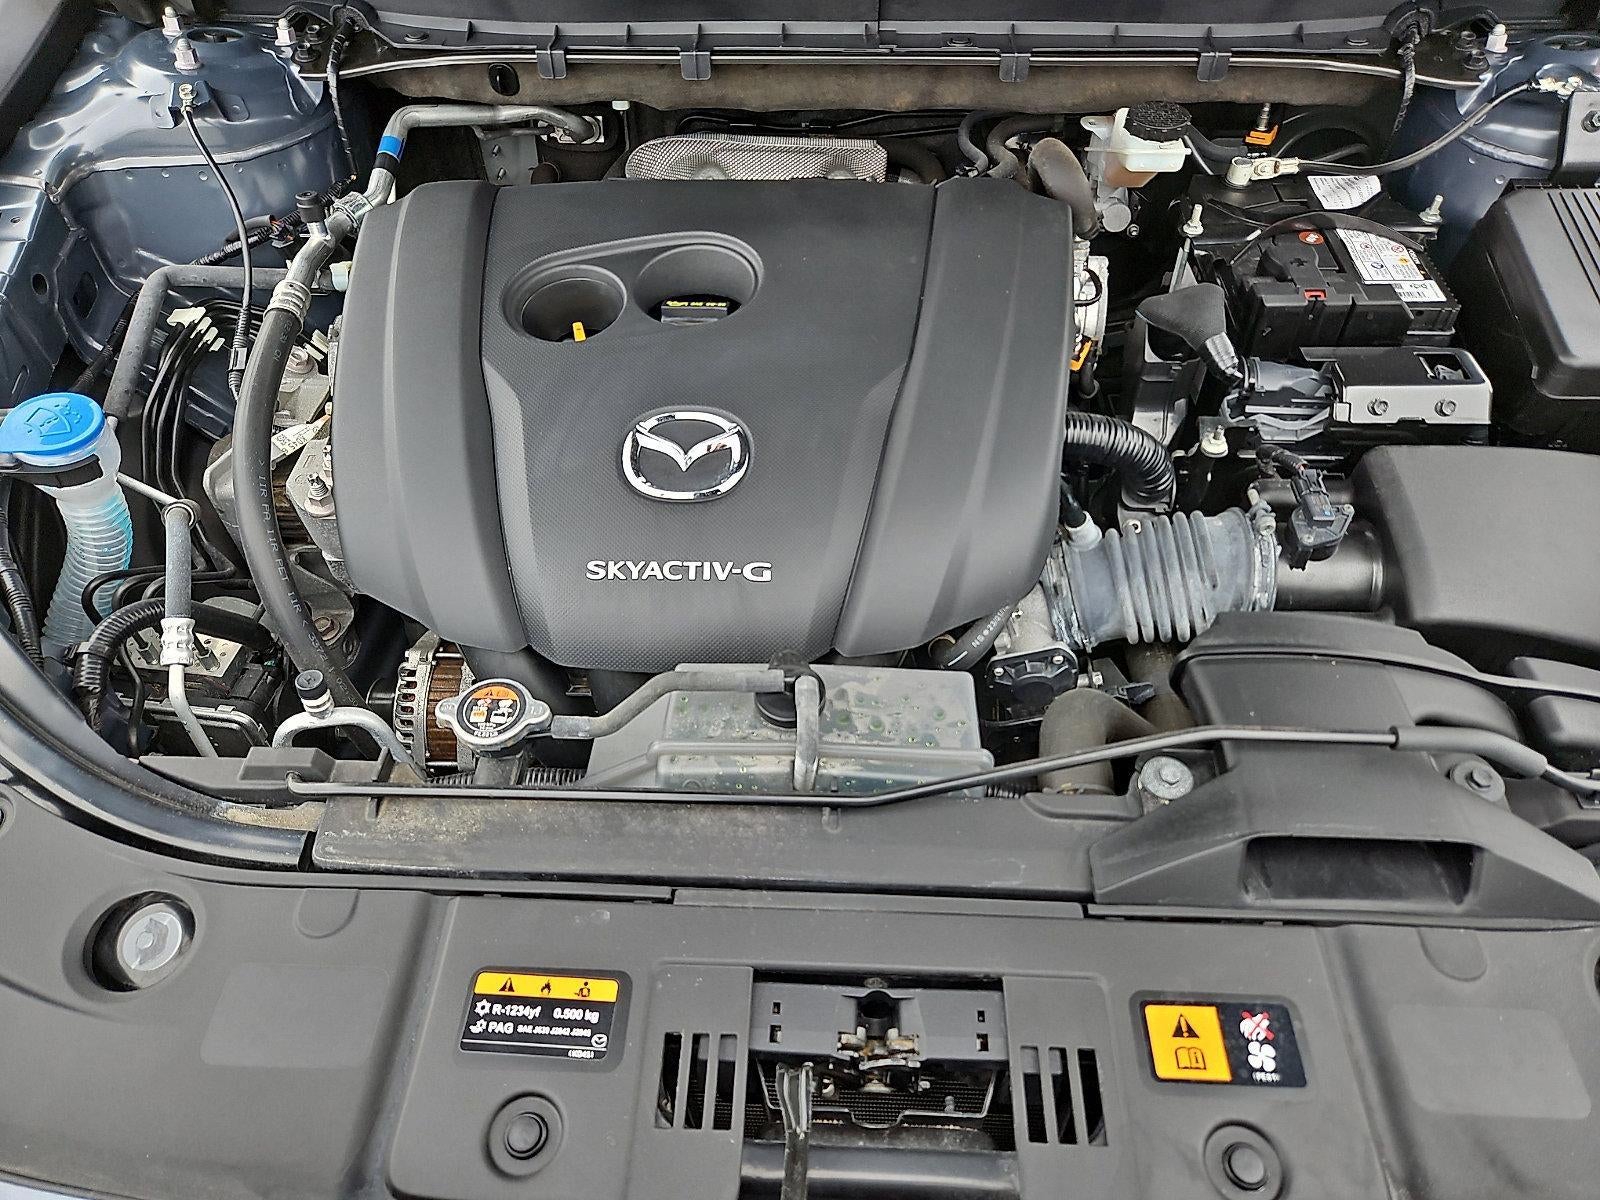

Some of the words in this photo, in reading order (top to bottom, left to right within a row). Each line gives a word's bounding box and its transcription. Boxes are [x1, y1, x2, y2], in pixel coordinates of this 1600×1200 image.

[275, 557, 291, 582] PET
[586, 560, 773, 583] SKYACTIV-G
[491, 1003, 542, 1020] R-1234yf
[553, 1007, 584, 1021] 0.500
[584, 1009, 600, 1024] kg
[487, 1020, 514, 1034] PAG
